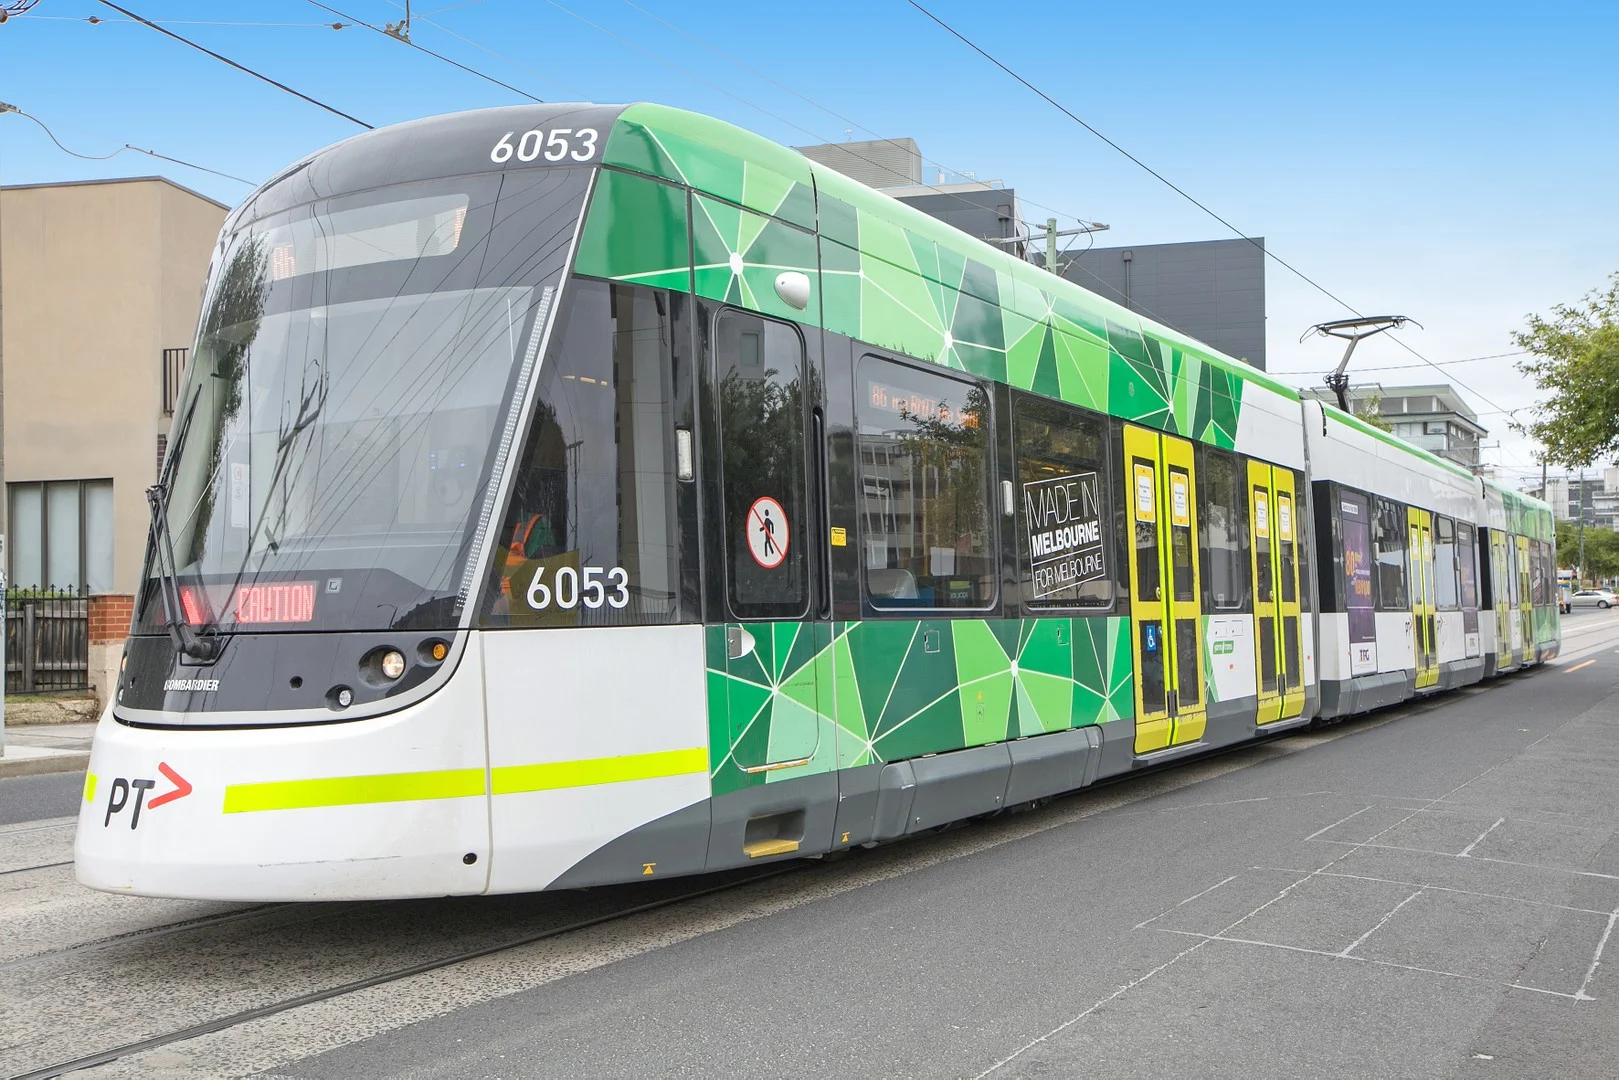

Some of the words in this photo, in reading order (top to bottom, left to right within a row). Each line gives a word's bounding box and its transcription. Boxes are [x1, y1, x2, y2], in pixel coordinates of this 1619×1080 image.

[490, 128, 599, 164] 6053
[1027, 482, 1080, 530] MADE
[1081, 479, 1098, 518] IN
[1031, 520, 1100, 558] MELBOURNE
[526, 566, 630, 610] 6053
[1035, 566, 1054, 590] FOR
[1054, 552, 1103, 583] MELBOURNE
[238, 584, 314, 623] CAUTION
[163, 679, 220, 692] BOMBARDIER
